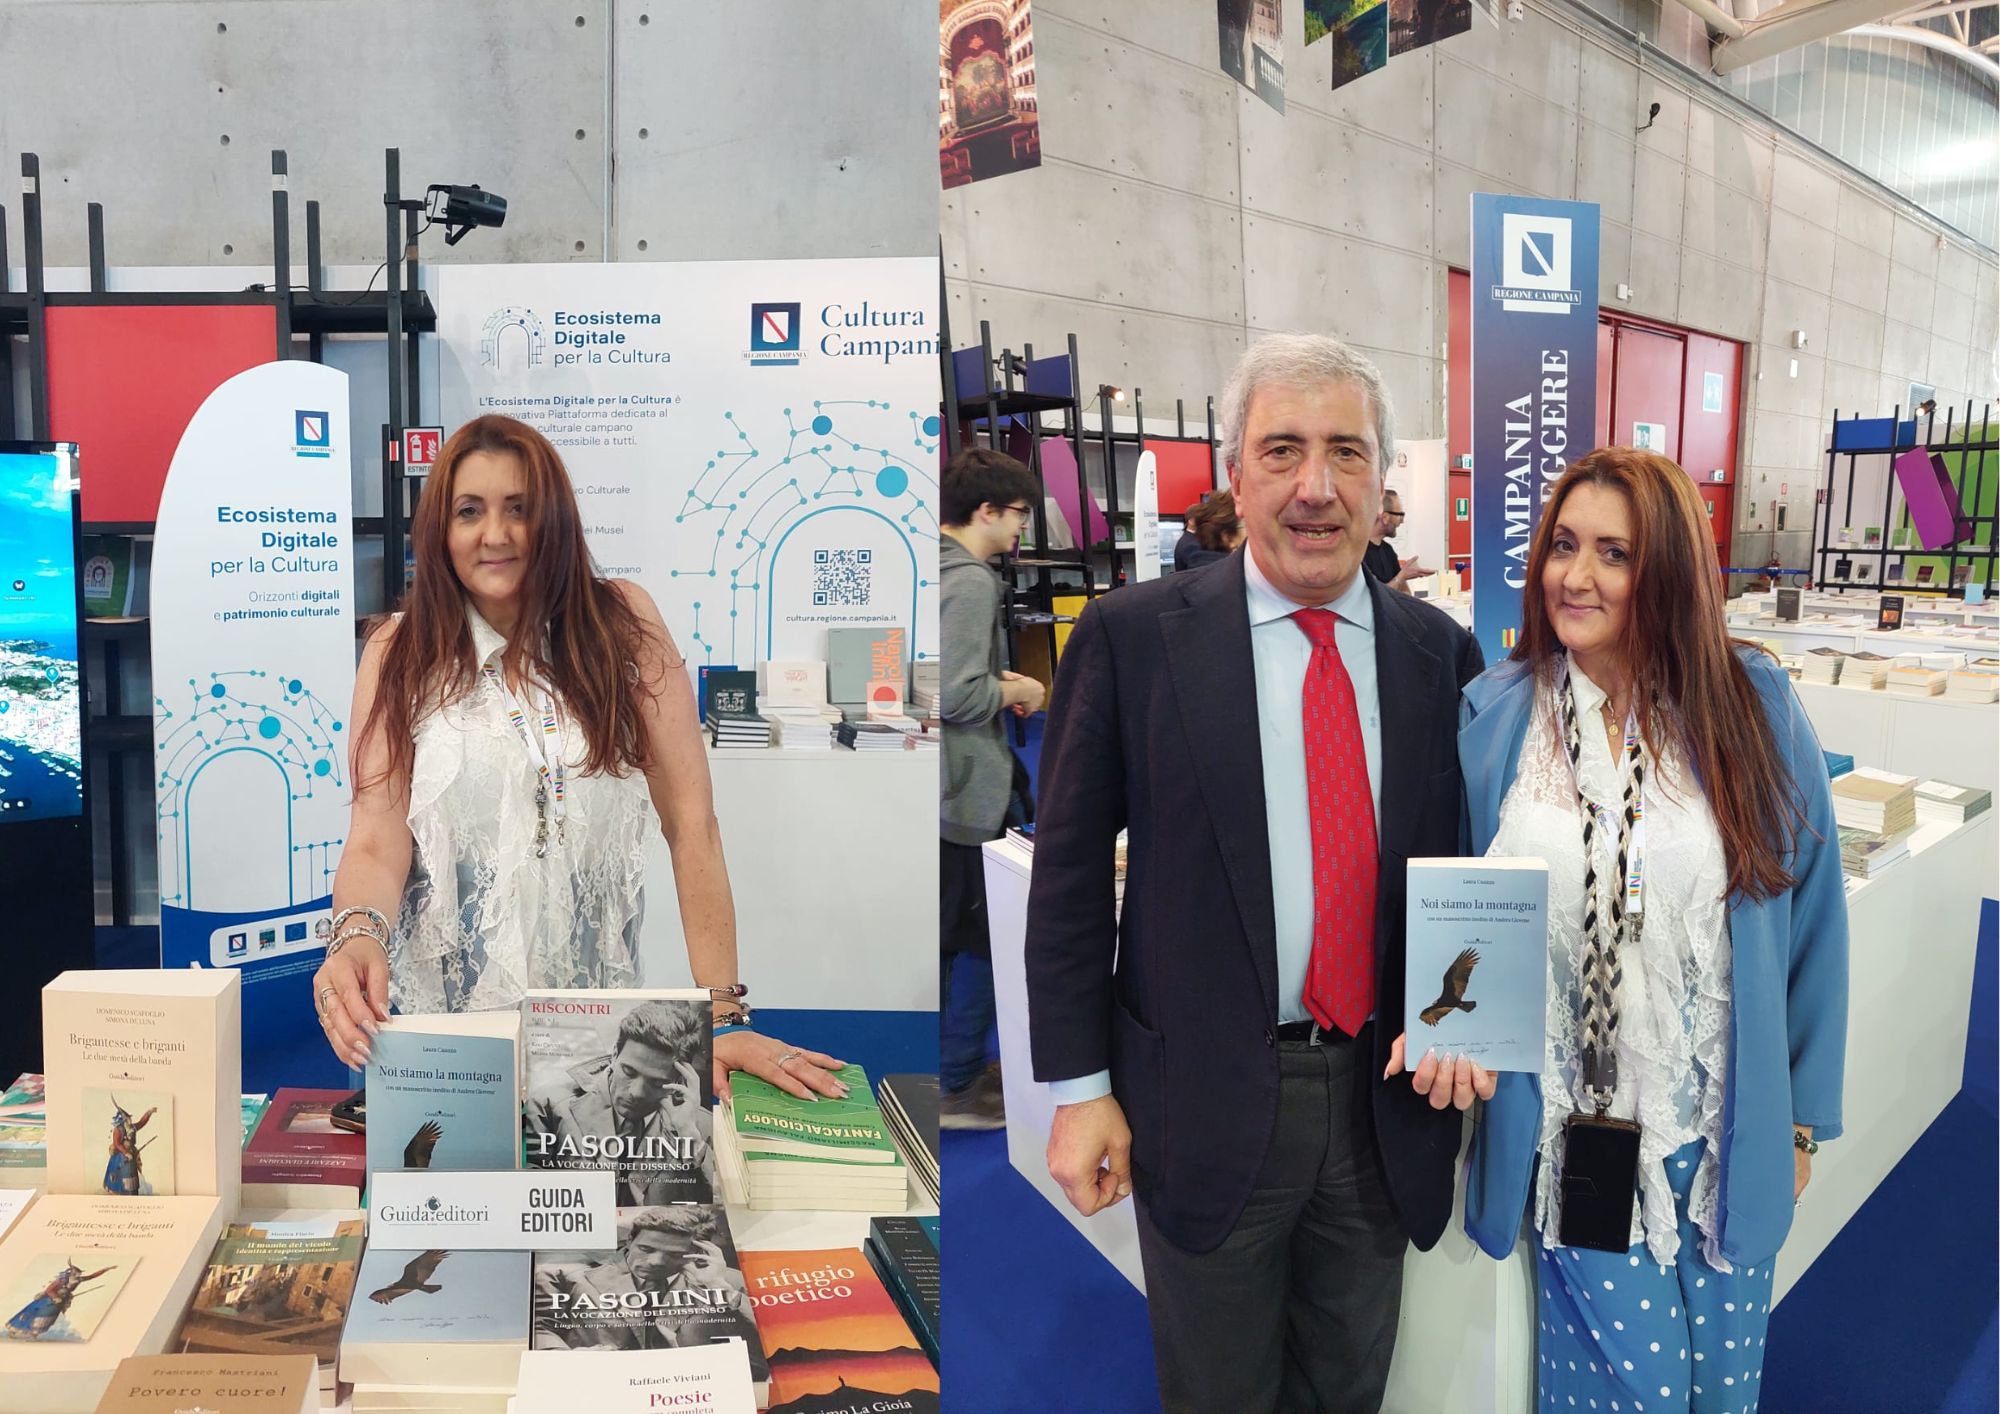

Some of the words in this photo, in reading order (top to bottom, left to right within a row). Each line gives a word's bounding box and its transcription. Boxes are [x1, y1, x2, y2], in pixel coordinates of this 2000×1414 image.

[1494, 288, 1533, 299] REGIONE
[1534, 291, 1579, 302] CAMPANIA
[555, 310, 661, 325] Ecosistema
[821, 301, 924, 328] Cultura
[555, 330, 626, 348] Digitale
[820, 332, 941, 364] Campani
[554, 353, 582, 368] per
[588, 349, 602, 363] la
[608, 349, 671, 364] Cultura
[480, 397, 550, 406] L'Ecosistema
[553, 396, 594, 407] Digitale
[598, 397, 616, 407] per
[619, 395, 628, 404] la
[631, 395, 671, 404] Cultura
[548, 409, 608, 419] Piattaforma
[611, 408, 656, 418] dedicata
[659, 408, 668, 417] al
[537, 424, 582, 433] culturale
[585, 424, 632, 433] campano
[1540, 349, 1568, 522] EGGERE
[551, 437, 600, 446] ccessibile
[613, 436, 637, 446] tutti.
[586, 485, 631, 494] Culturale
[1503, 392, 1532, 589] CAMPANIA
[218, 506, 337, 523] Ecosistema
[595, 525, 624, 535] Musei
[262, 531, 338, 552] Digitale
[211, 561, 243, 578] per
[249, 556, 265, 572] la
[272, 556, 338, 572] Cultura
[249, 590, 299, 602] Orizzonti
[301, 589, 340, 602] digitali
[214, 611, 221, 620] e
[223, 607, 288, 622] patrimonio
[290, 606, 340, 618] culturale
[785, 614, 897, 623] cultura.regione.campania.it
[1421, 898, 1439, 909] Noi
[1441, 899, 1472, 909] siamo
[1474, 899, 1483, 909] la
[1486, 901, 1537, 913] montagna
[531, 1002, 611, 1015] RISCONTRI
[69, 1033, 131, 1050] Brigantesse
[133, 1041, 140, 1049] e
[142, 1038, 185, 1054] briganti
[82, 1051, 92, 1060] Le
[94, 1053, 107, 1061] due
[129, 1054, 147, 1064] della
[148, 1055, 172, 1065] banda
[379, 1065, 398, 1077] Noi
[400, 1068, 433, 1079] siamo
[435, 1069, 445, 1080] la
[447, 1071, 502, 1084] montagna
[743, 1113, 882, 1140] FANTACALCIOLOGY
[538, 1132, 694, 1159] PASOLINI
[542, 1160, 555, 1168] LA
[557, 1160, 617, 1170] VOCAZIONE
[619, 1162, 638, 1171] DEL
[640, 1163, 690, 1171] DISSENSO
[529, 1188, 585, 1208] GUIDA
[380, 1205, 430, 1222] Guida
[436, 1205, 489, 1223] editori
[521, 1213, 593, 1232] EDITORI
[756, 1264, 855, 1289] rifugio
[549, 1288, 728, 1310] PASOLINI
[572, 1310, 642, 1319] VOCAZIONE
[643, 1309, 666, 1317] DEL
[668, 1307, 726, 1316] DISSENSO
[629, 1376, 671, 1386] Raffaele
[673, 1373, 711, 1383] Viviani
[128, 1387, 201, 1397] Povero
[215, 1386, 286, 1397] cuore!
[650, 1390, 712, 1407] Poesie
[851, 1406, 870, 1414] La
[872, 1399, 912, 1413] Gioia
